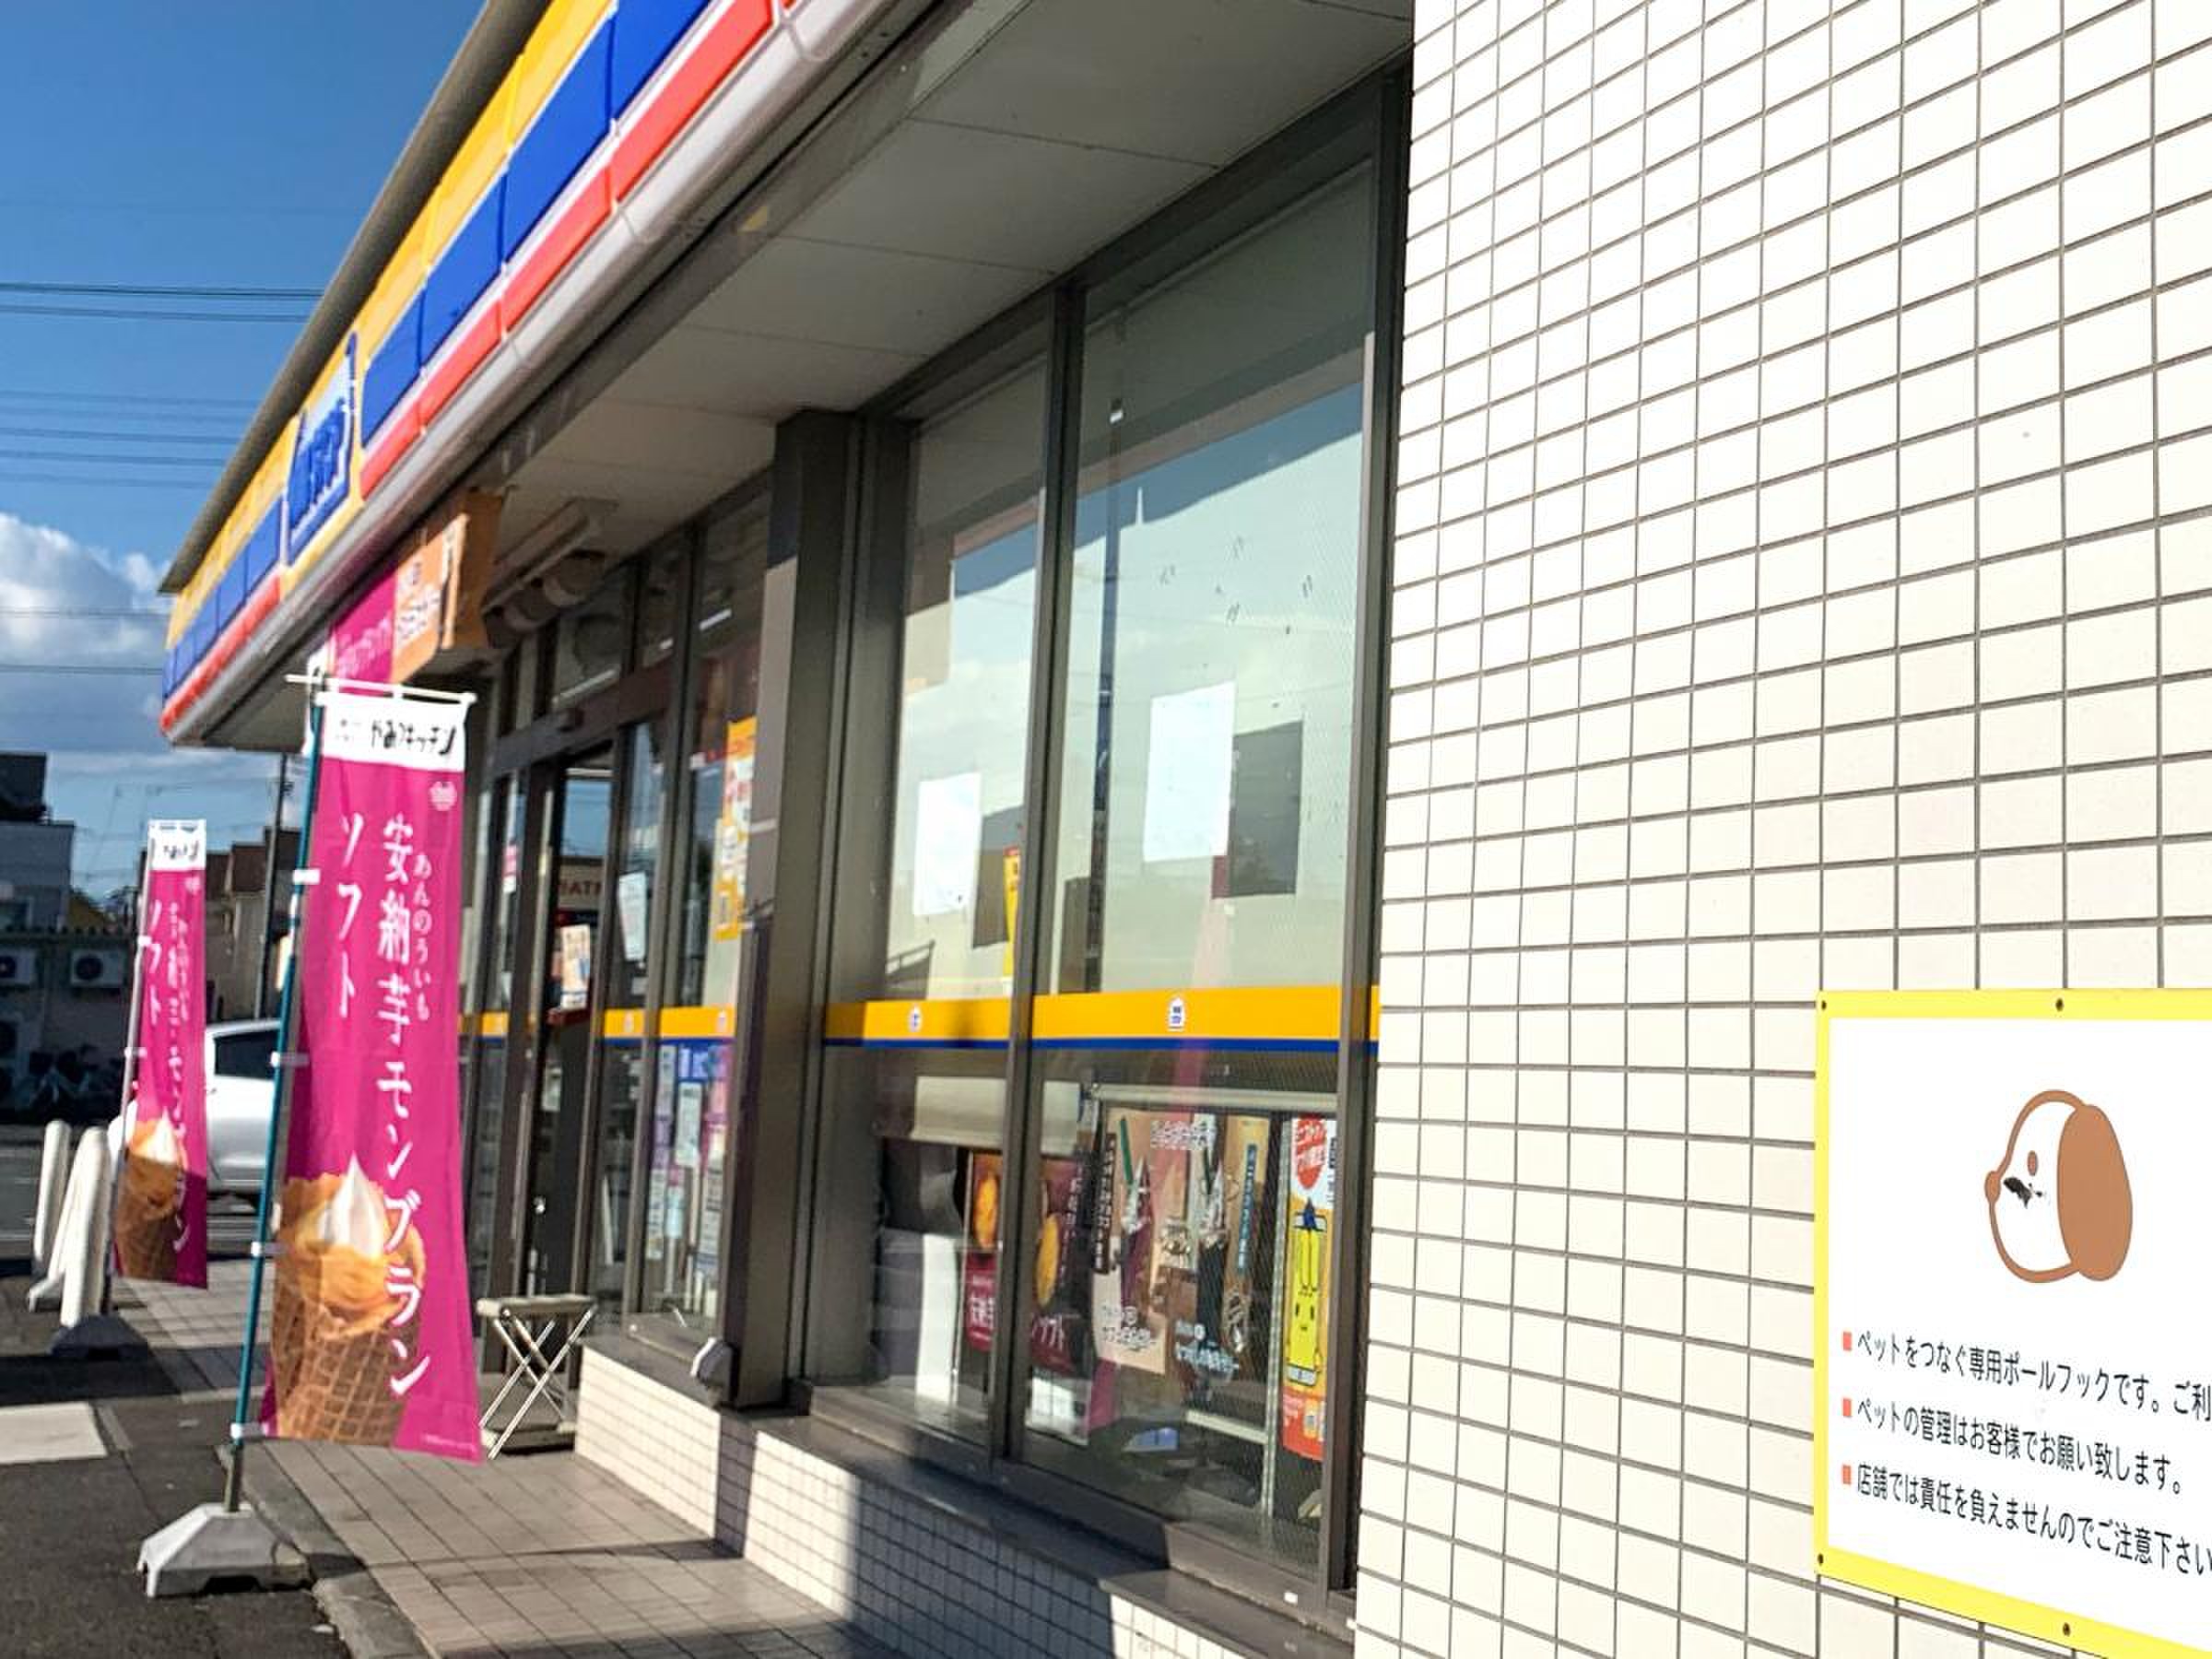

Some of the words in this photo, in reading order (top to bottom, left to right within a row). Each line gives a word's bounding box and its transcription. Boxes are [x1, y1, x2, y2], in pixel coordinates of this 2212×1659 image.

[336, 812, 364, 1018] ソフト
[413, 852, 433, 1022] あんのういも
[376, 812, 431, 1396] 安納芋モンブラン
[1856, 1397, 2182, 1496] ペットの管理はお客様でお願い致します。
